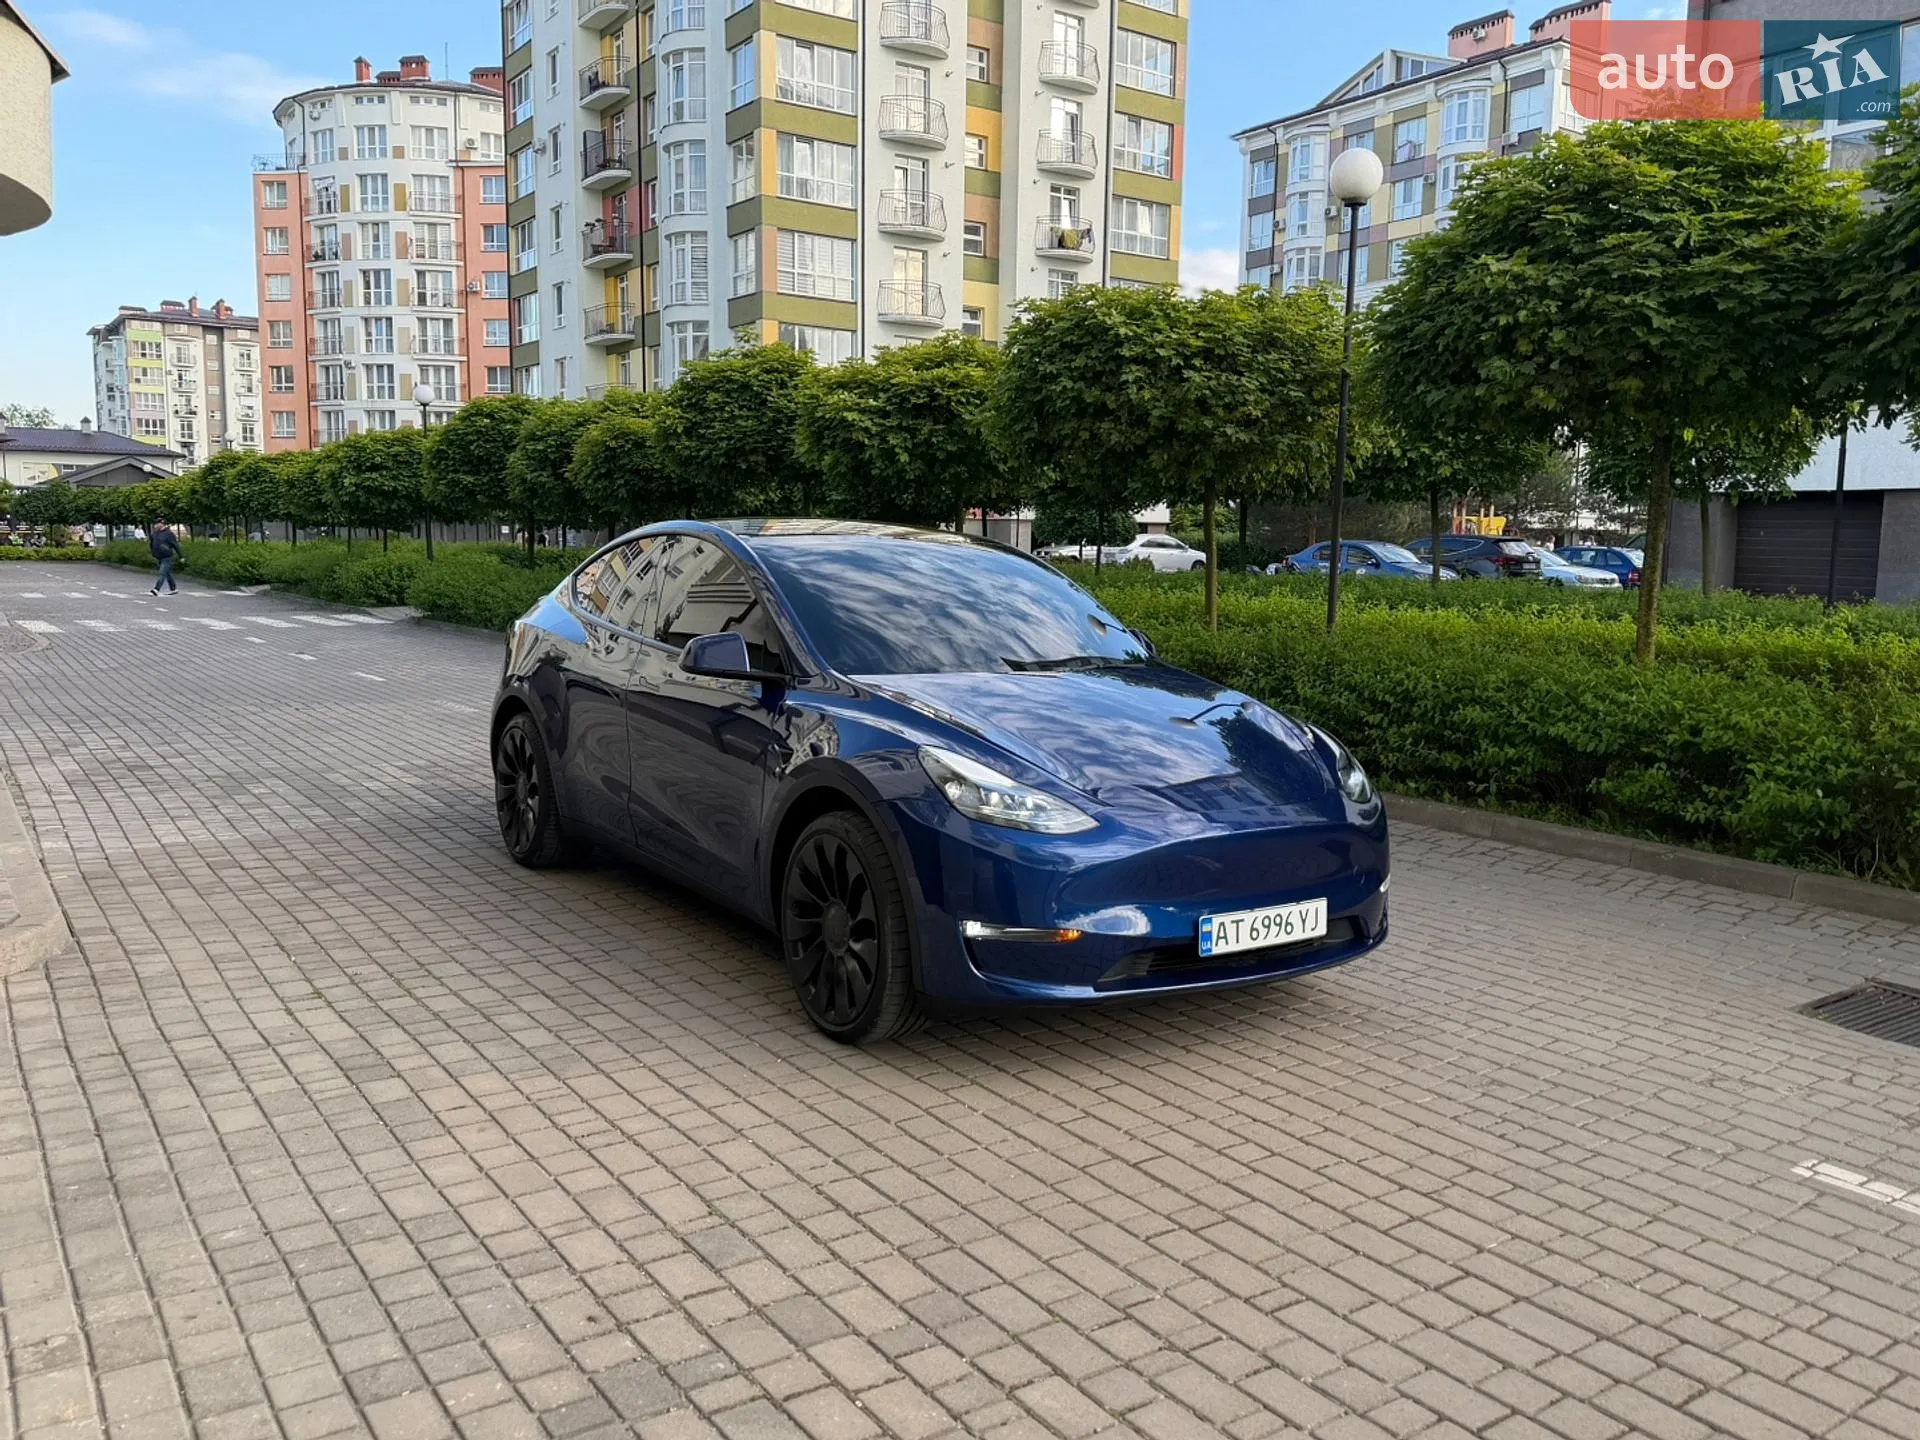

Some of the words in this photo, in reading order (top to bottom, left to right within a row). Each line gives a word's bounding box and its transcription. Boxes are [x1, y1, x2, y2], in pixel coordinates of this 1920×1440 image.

[1215, 919, 1245, 947] AT
[1250, 911, 1294, 941] 6996
[1300, 907, 1319, 933] YJ
